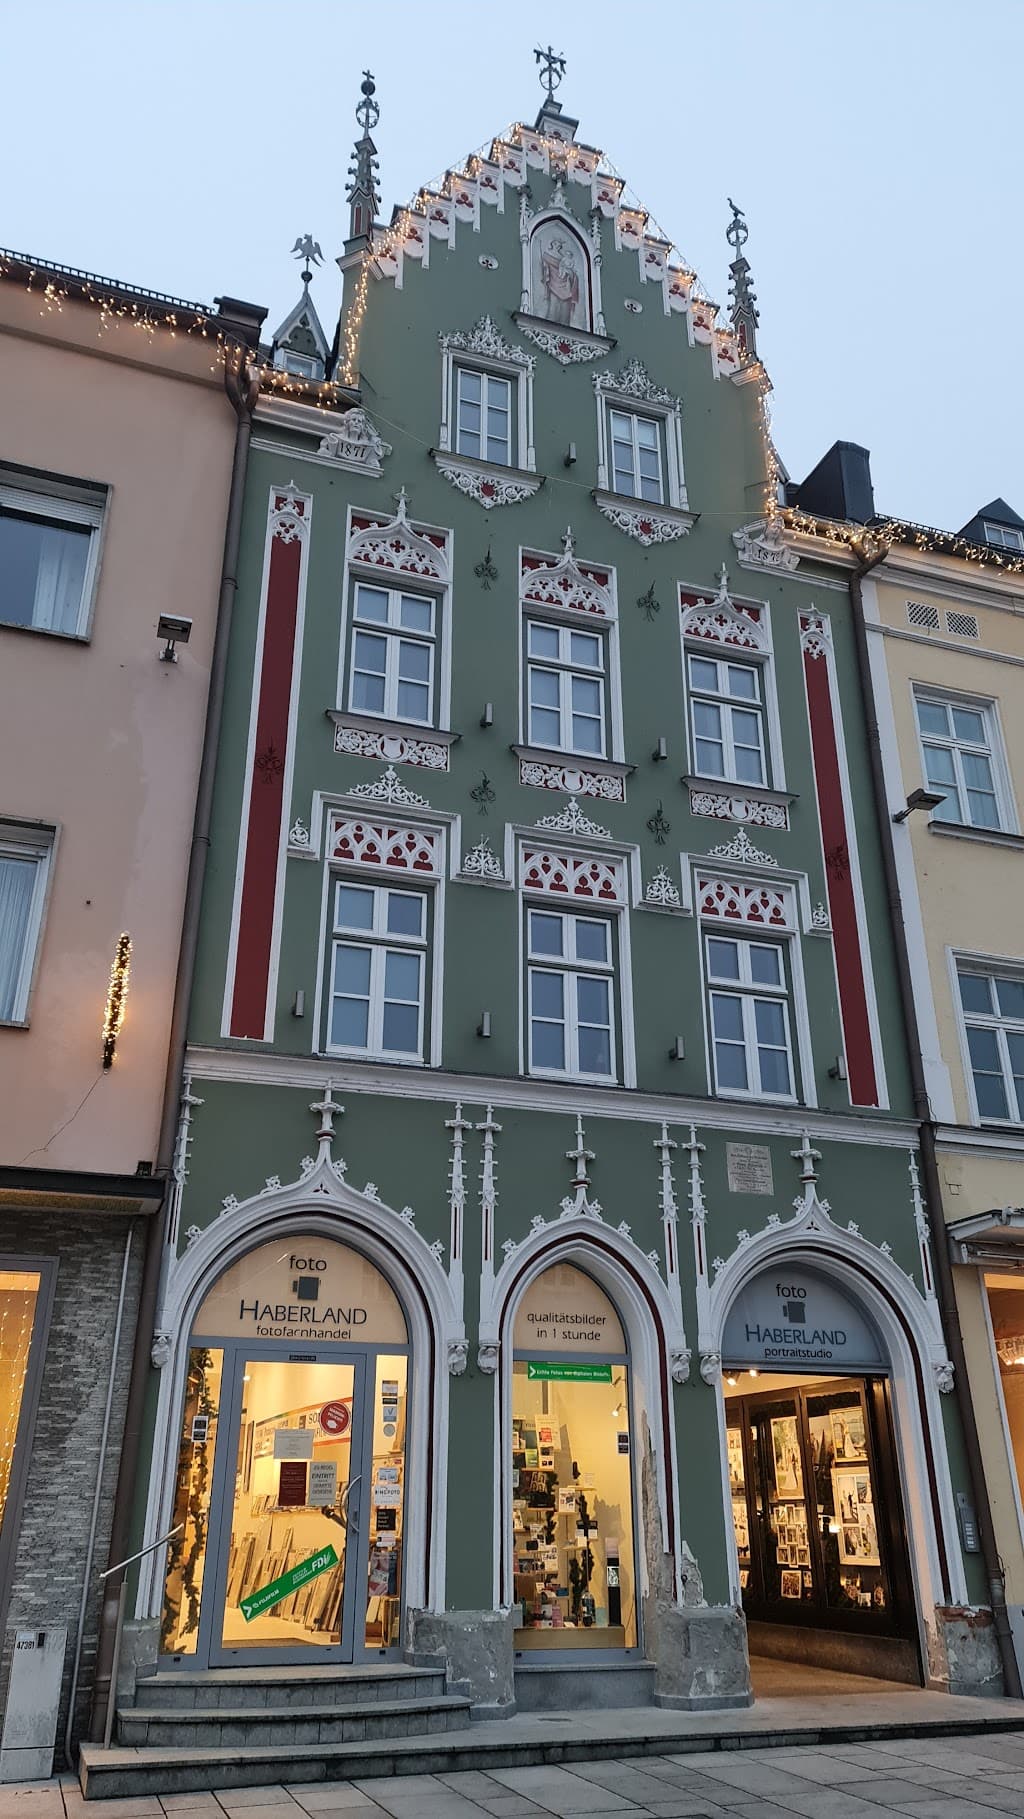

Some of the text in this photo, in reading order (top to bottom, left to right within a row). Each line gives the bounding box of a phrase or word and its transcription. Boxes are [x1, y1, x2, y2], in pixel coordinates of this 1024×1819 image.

[340, 442, 366, 458] 1871
[289, 1255, 328, 1271] foto
[776, 1283, 807, 1299] foto
[240, 1299, 367, 1325] HABERLAND
[527, 1312, 607, 1326] qualitätsbilder
[536, 1328, 548, 1339] in
[562, 1329, 601, 1341] stunde
[745, 1323, 847, 1346] HABERLAND
[764, 1347, 833, 1359] portraitstudio
